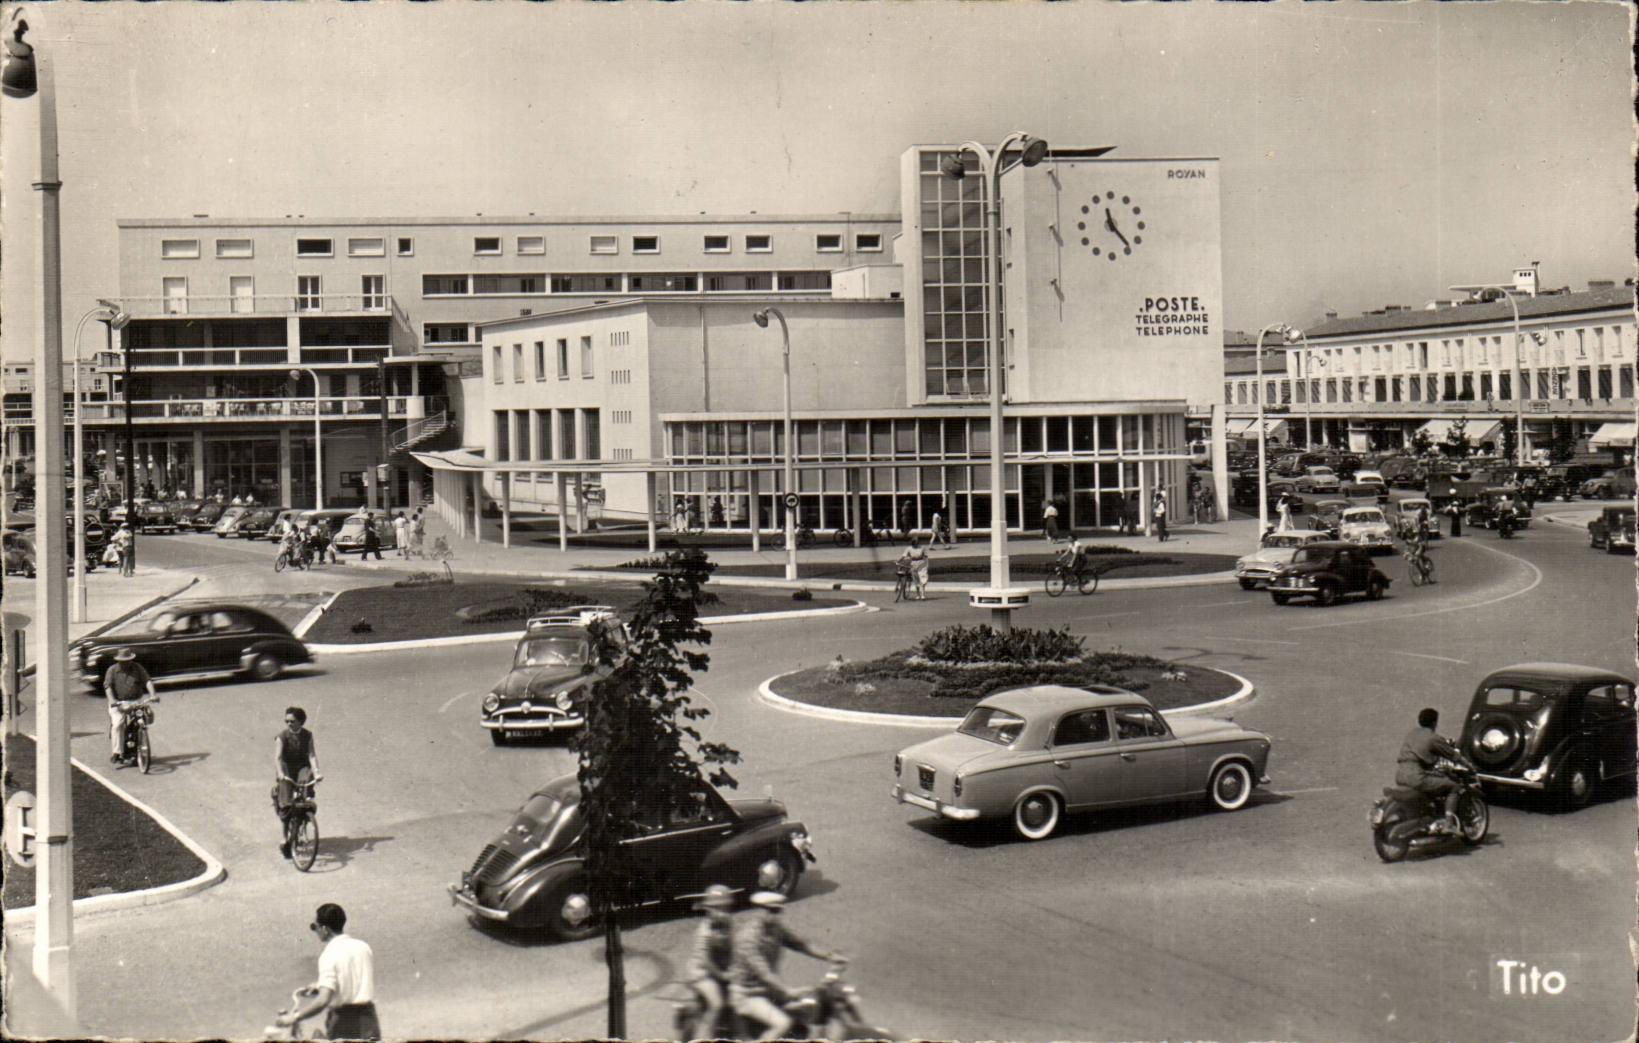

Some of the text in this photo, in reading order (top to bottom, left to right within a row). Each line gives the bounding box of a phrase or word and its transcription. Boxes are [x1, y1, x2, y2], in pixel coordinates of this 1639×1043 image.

[1167, 169, 1206, 179] ROYAN
[1135, 313, 1209, 324] TELEGRAPHE
[1135, 325, 1209, 336] TELEPHONE
